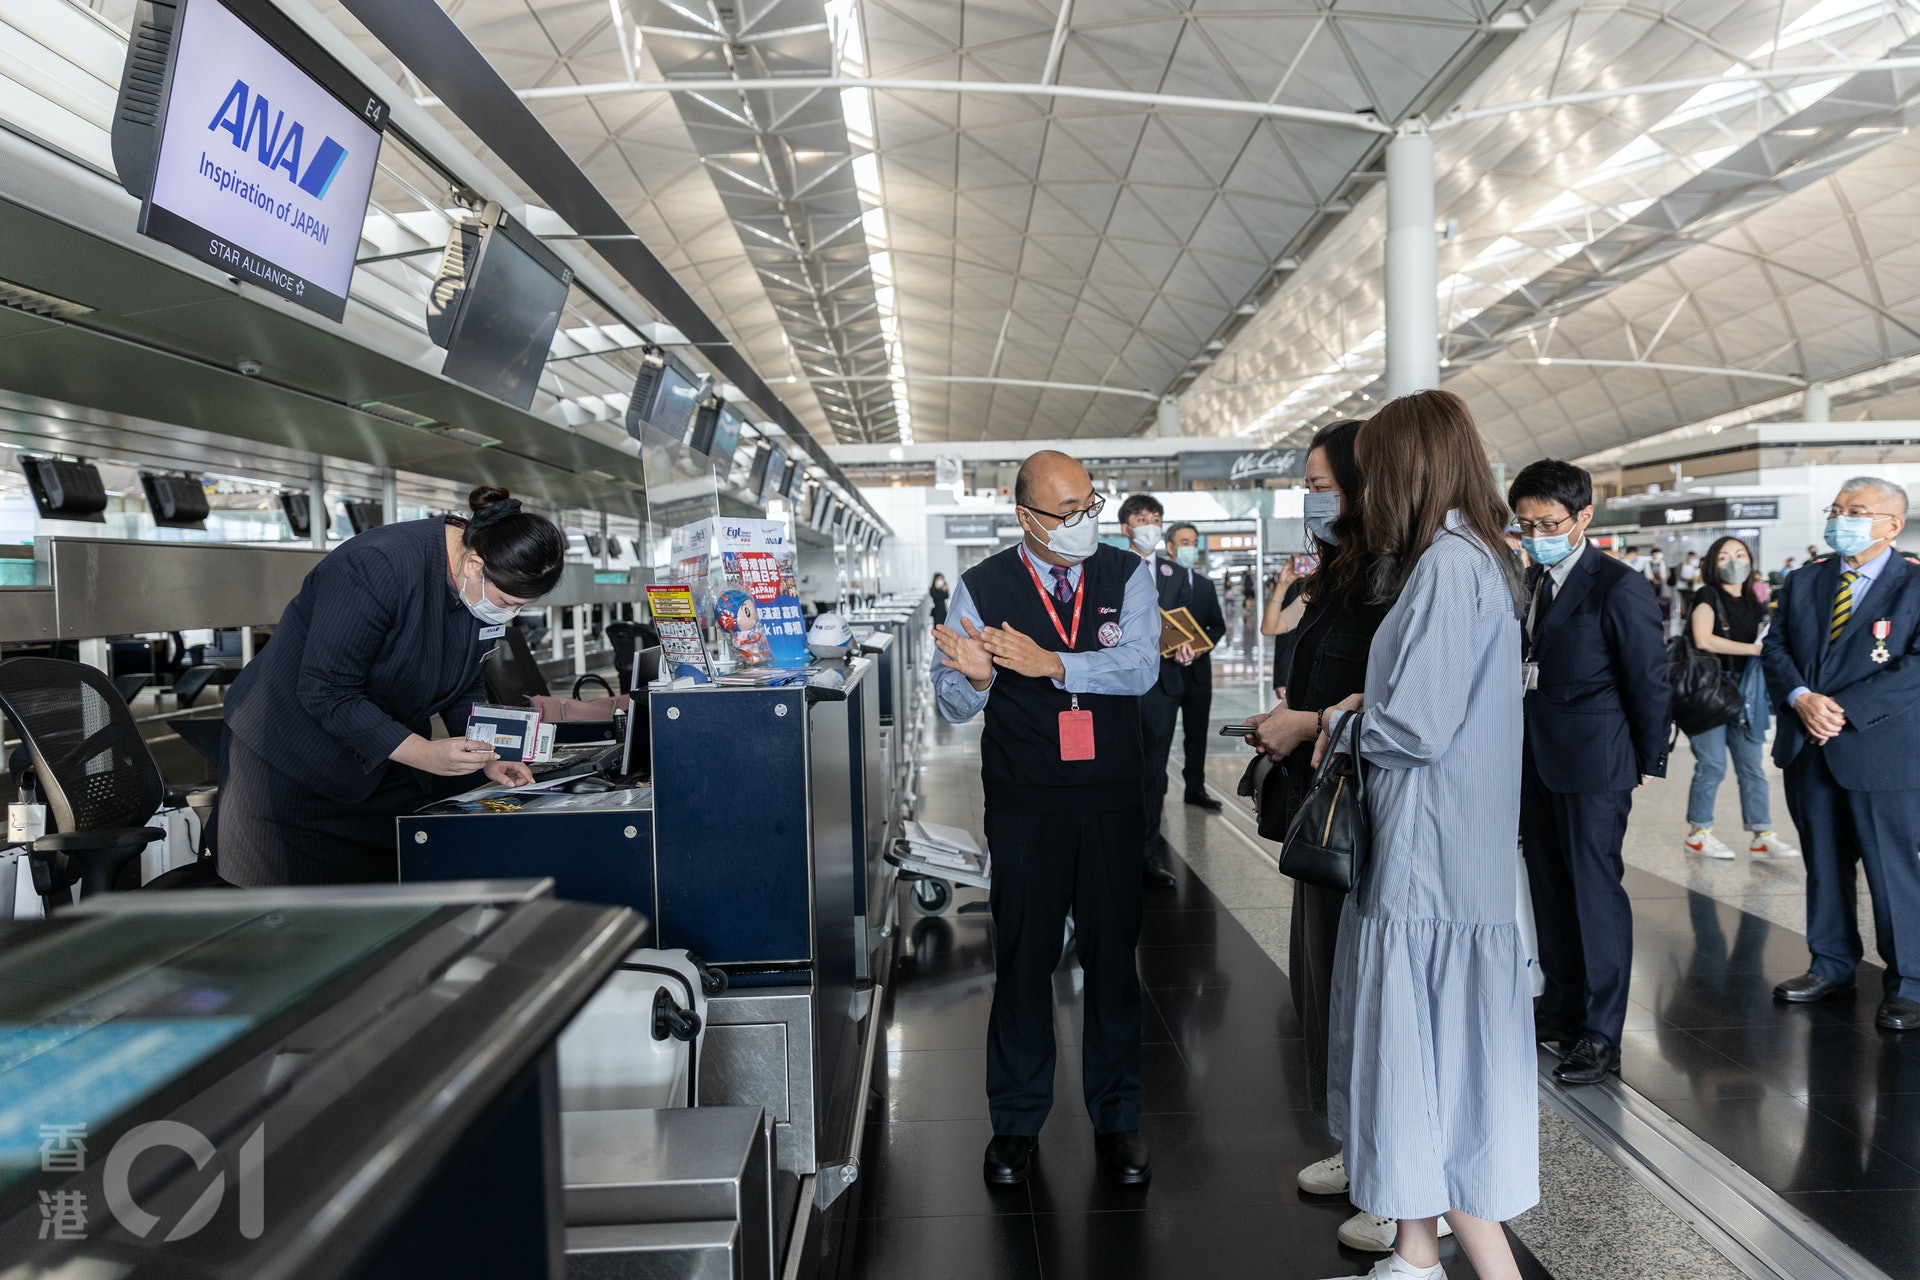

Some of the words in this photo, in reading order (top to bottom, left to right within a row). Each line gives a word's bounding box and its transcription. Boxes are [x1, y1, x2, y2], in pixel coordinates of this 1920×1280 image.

[365, 97, 381, 122] E4
[207, 79, 305, 185] ANA
[199, 151, 275, 216] Inspiration
[276, 201, 291, 223] of
[290, 208, 329, 246] JAPAN
[209, 239, 240, 266] STAR
[241, 254, 294, 292] ALLIANCE
[765, 537, 778, 545] ANA
[771, 623, 783, 636] in
